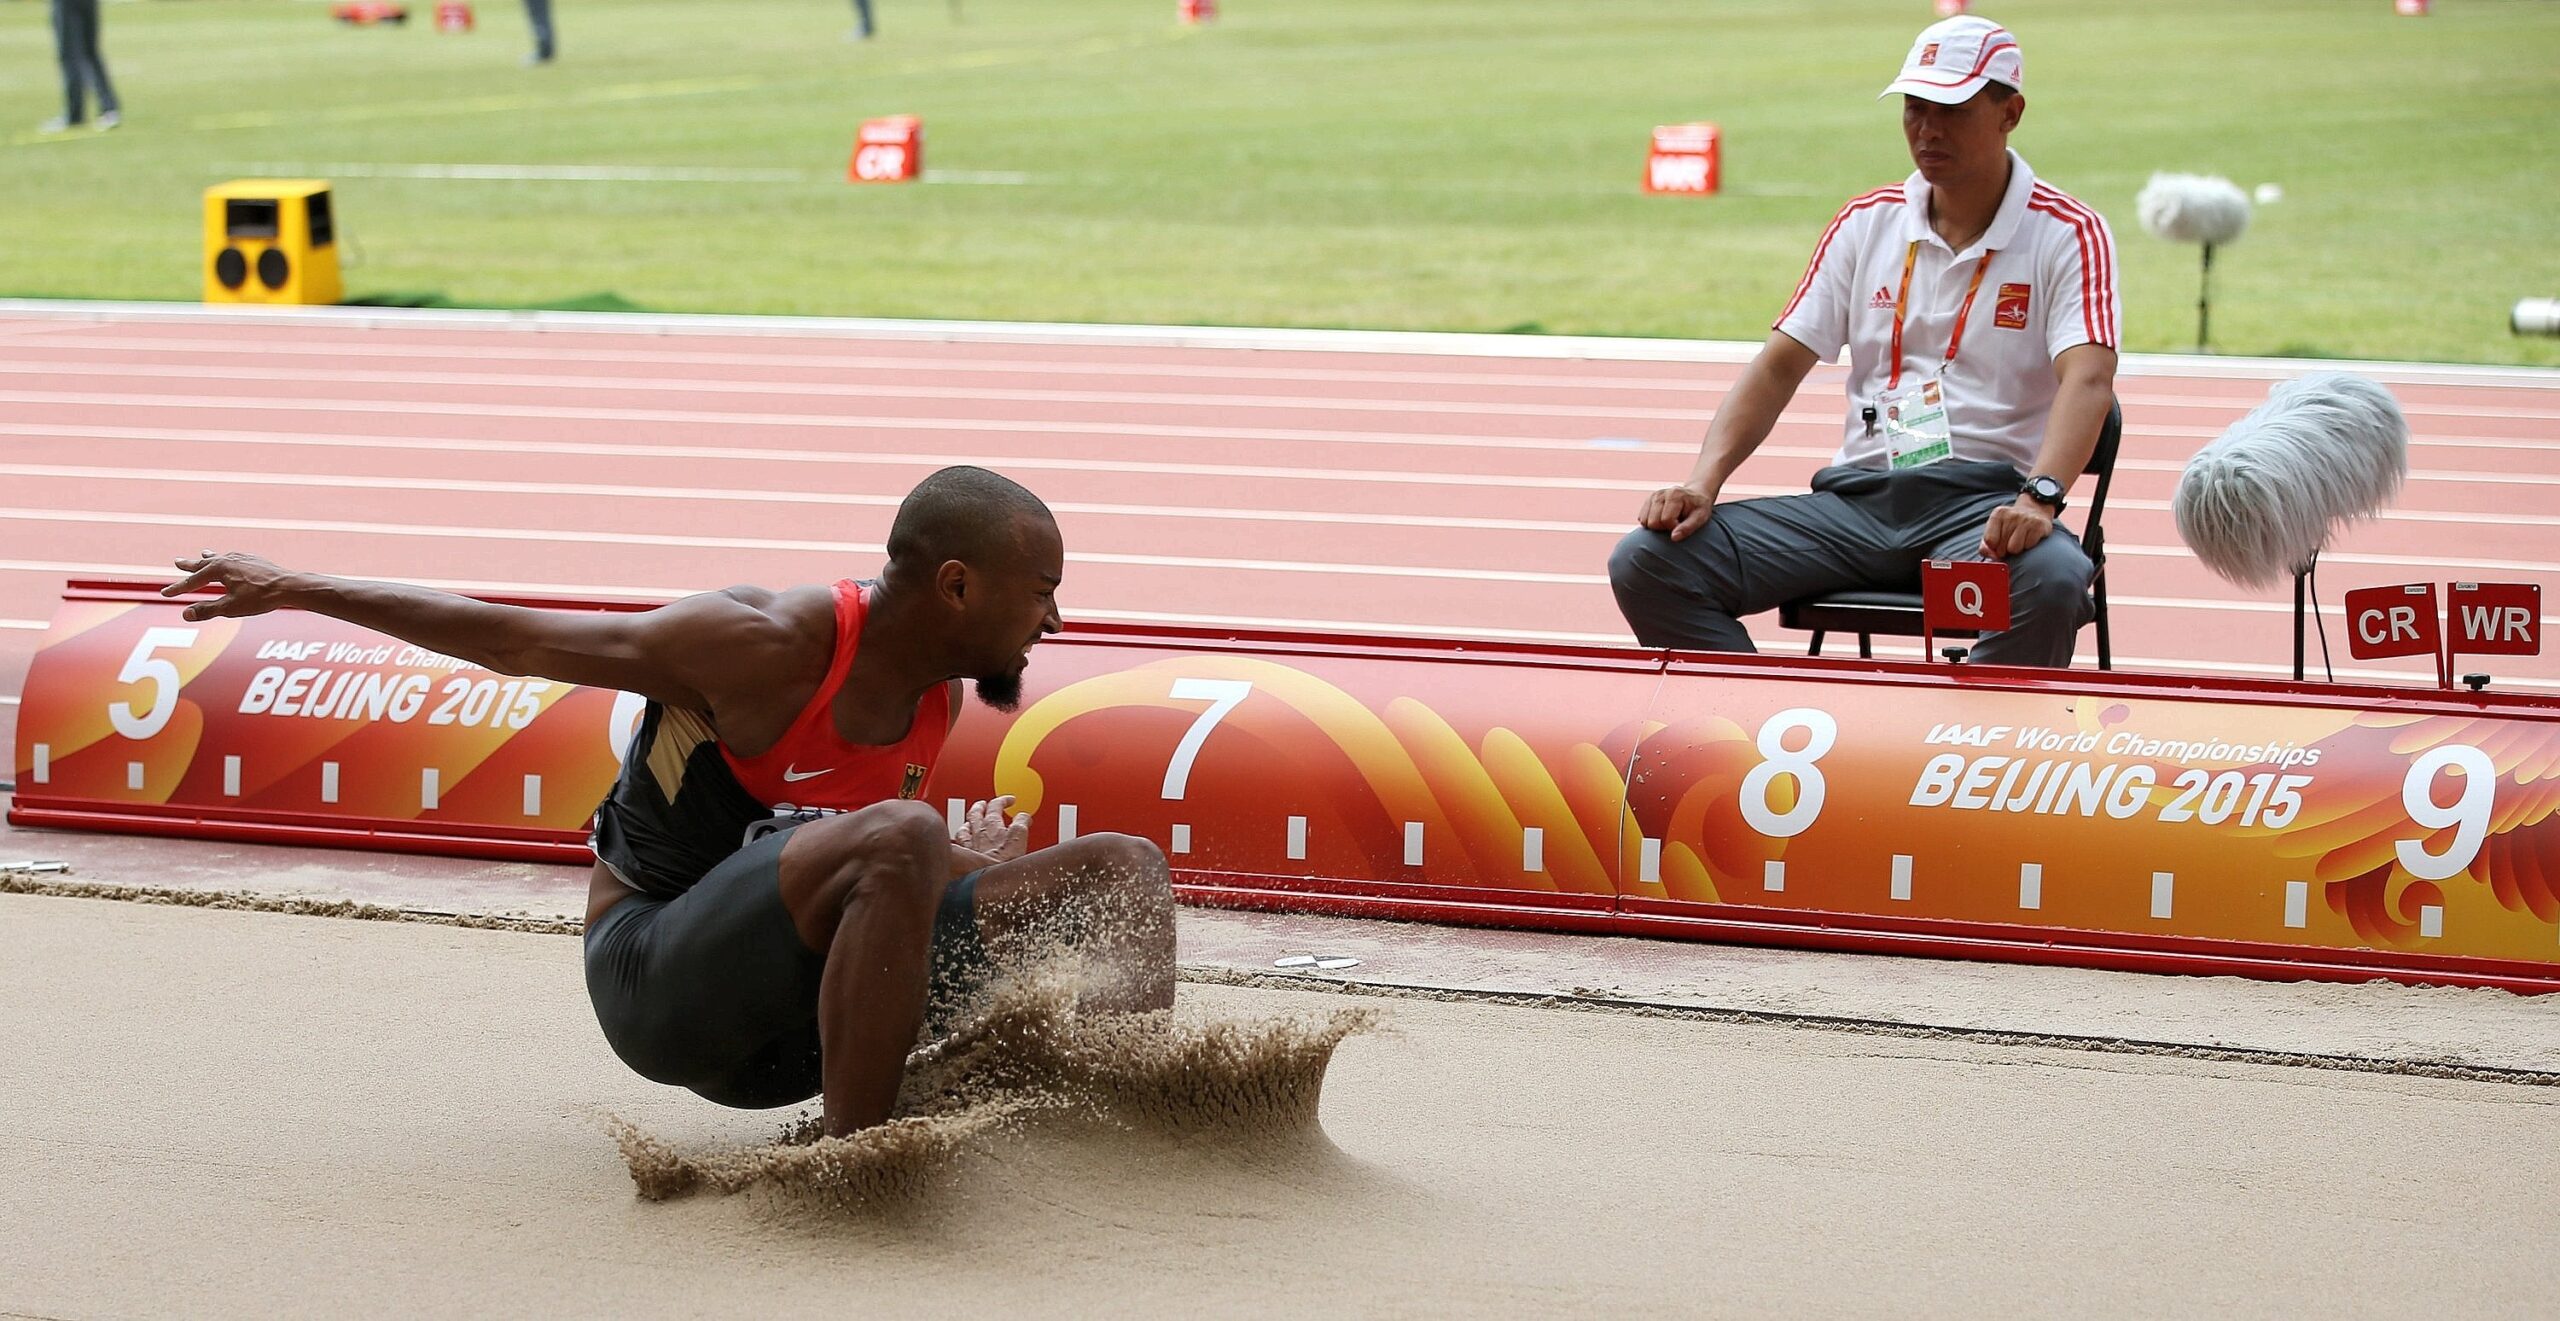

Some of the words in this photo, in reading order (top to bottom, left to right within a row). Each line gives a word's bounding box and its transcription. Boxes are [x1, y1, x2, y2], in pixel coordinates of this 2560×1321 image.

[1954, 581, 1984, 618] Q
[2358, 606, 2421, 645] CR
[2461, 605, 2532, 642] WR
[108, 626, 200, 741] 5
[256, 640, 326, 661] IAAF
[324, 643, 390, 665] World
[237, 666, 431, 723] BEIJING
[427, 678, 551, 730] 2015
[1161, 678, 1253, 801] 7
[1925, 723, 2013, 747] IAAF
[2013, 727, 2101, 751] World
[2106, 731, 2322, 768] Championships
[1739, 706, 1839, 838] 8
[1908, 753, 2156, 818] BEIJING
[2158, 768, 2313, 829] 2015
[2393, 744, 2498, 880] 9
